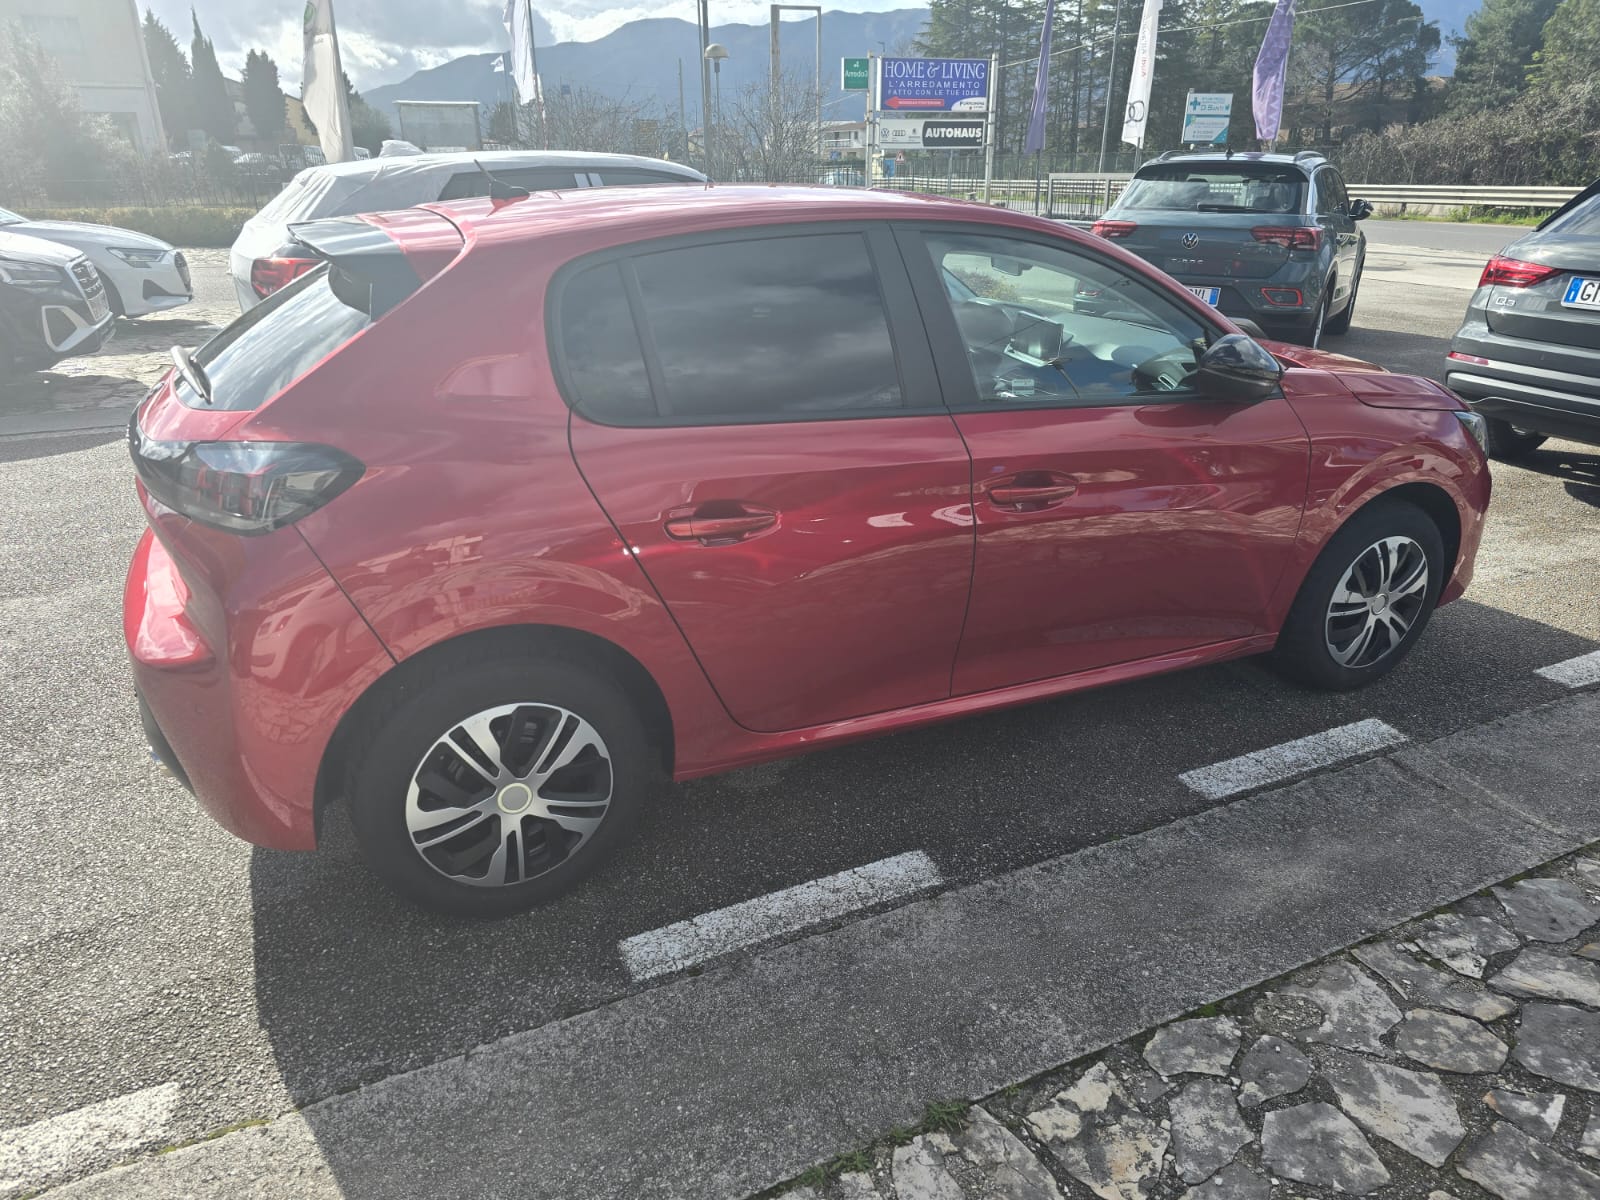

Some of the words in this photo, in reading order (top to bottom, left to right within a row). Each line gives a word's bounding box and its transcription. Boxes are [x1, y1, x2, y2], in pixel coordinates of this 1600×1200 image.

[885, 61, 925, 78] HOME
[927, 62, 940, 79] &
[942, 62, 985, 79] LIVING
[888, 80, 980, 89] L'ARREDAMENTO
[925, 127, 982, 138] AUTOHAUS
[1496, 297, 1515, 306] Q3
